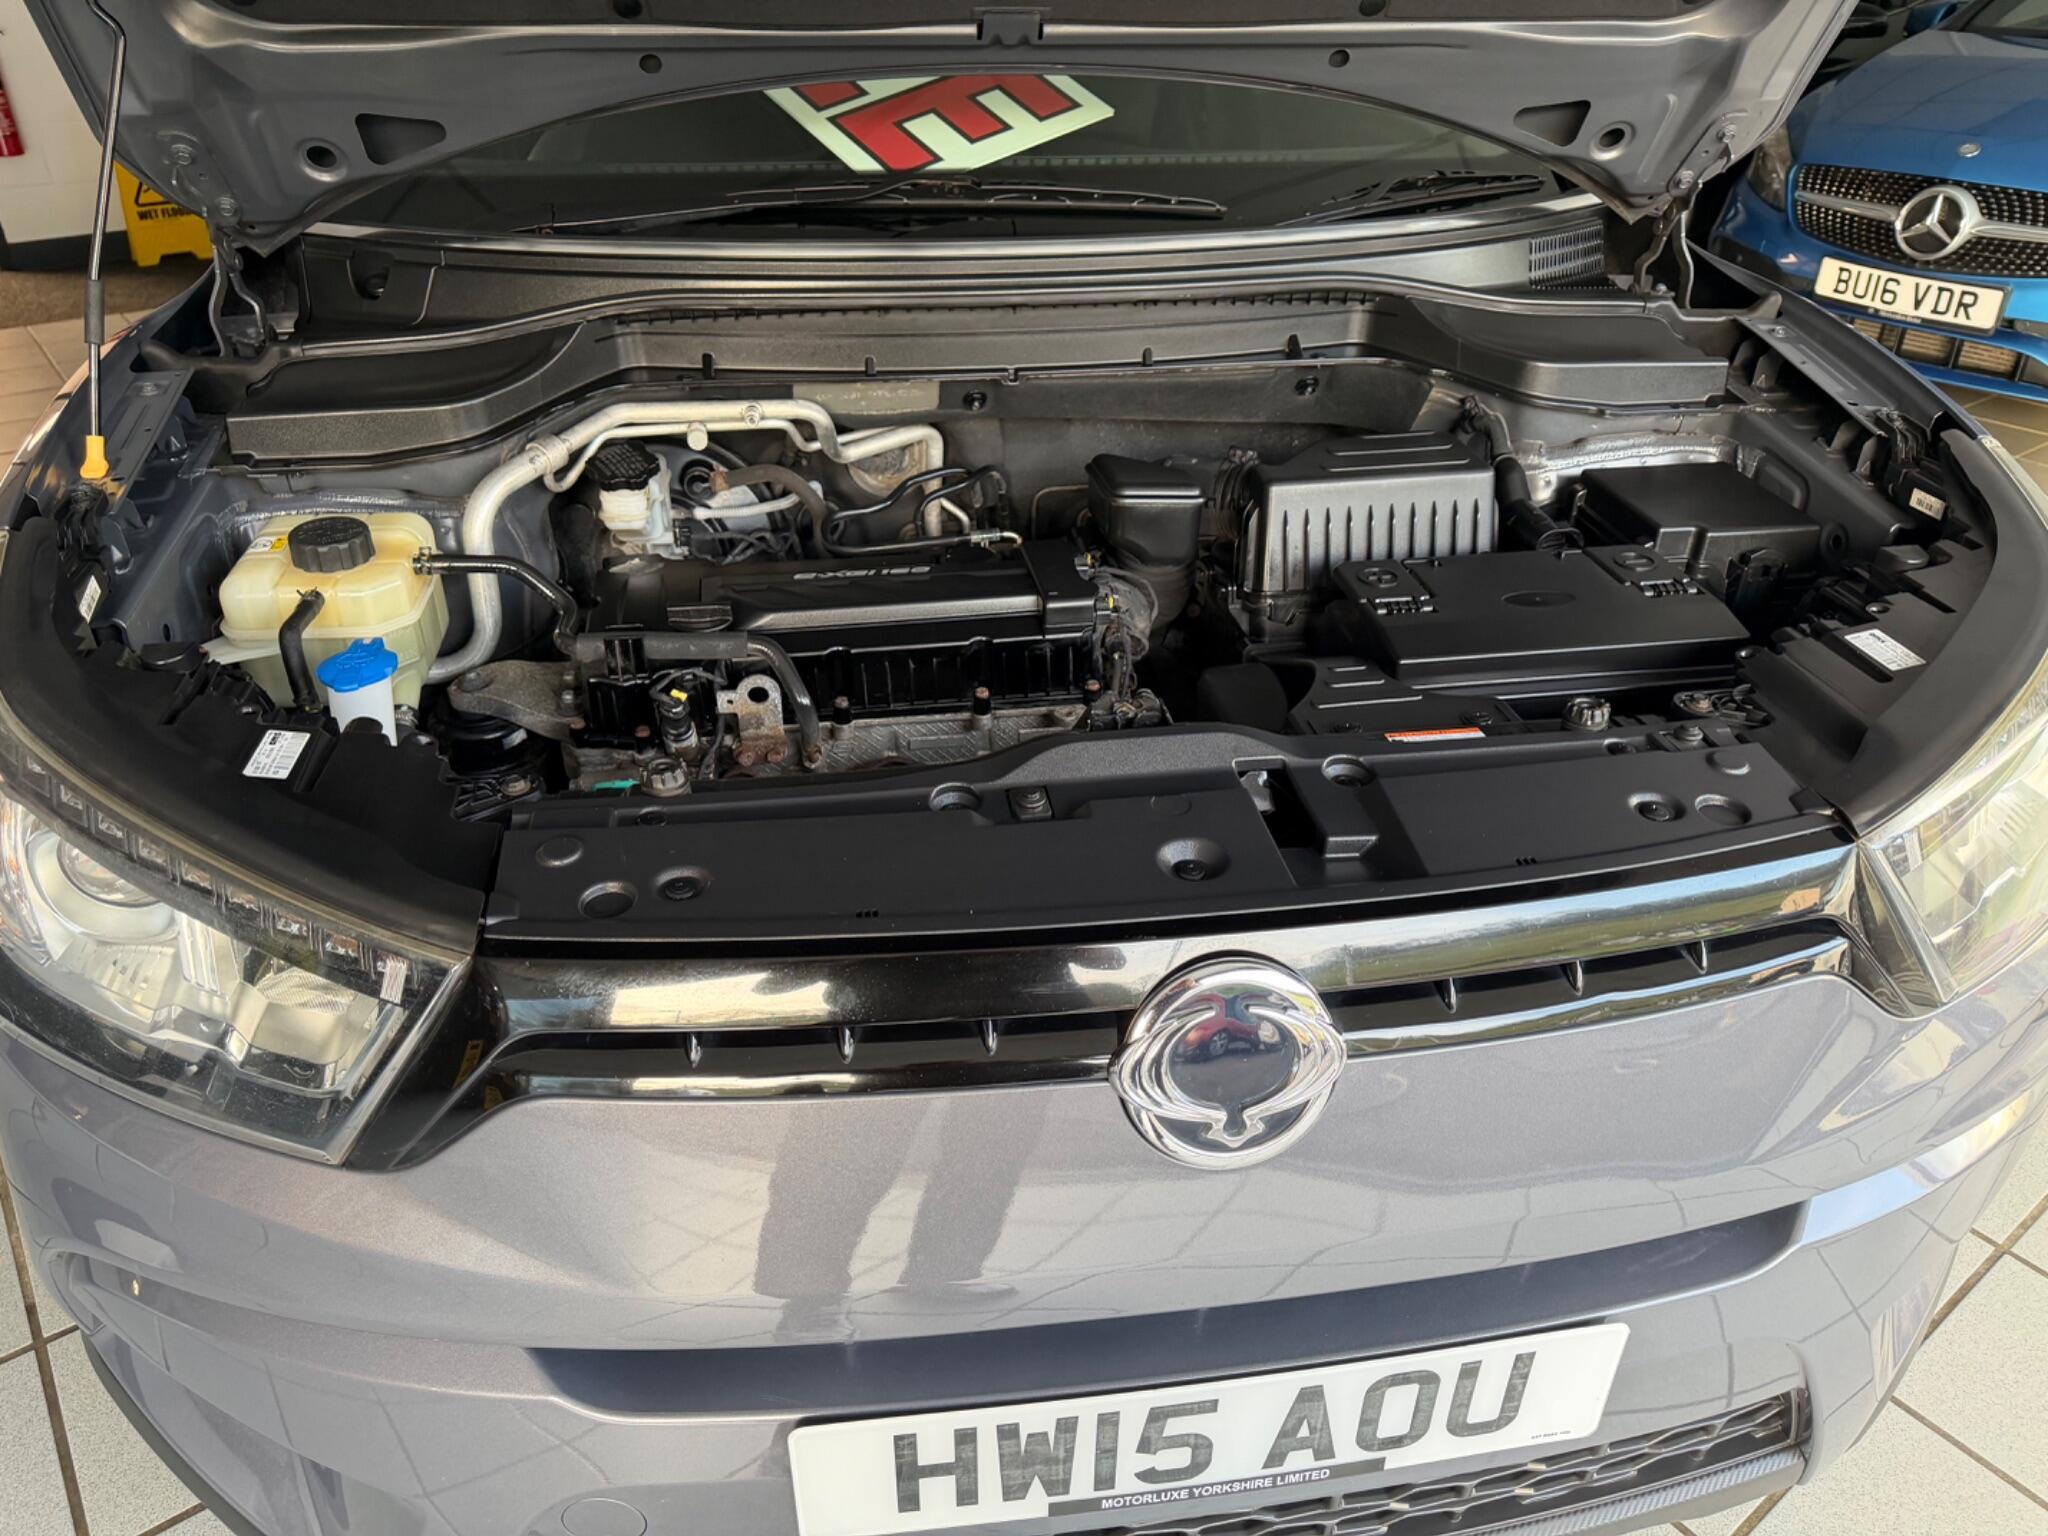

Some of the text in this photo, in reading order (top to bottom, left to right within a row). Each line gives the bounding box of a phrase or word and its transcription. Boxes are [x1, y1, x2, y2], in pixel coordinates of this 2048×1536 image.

[136, 208, 159, 221] WET
[1833, 267, 1901, 305] BU16
[1914, 282, 1979, 320] VDR
[893, 1352, 1537, 1513] HW15 AOU
[1102, 1468, 1331, 1509] MOTORLUXE YORKSHIRE LIMITED
